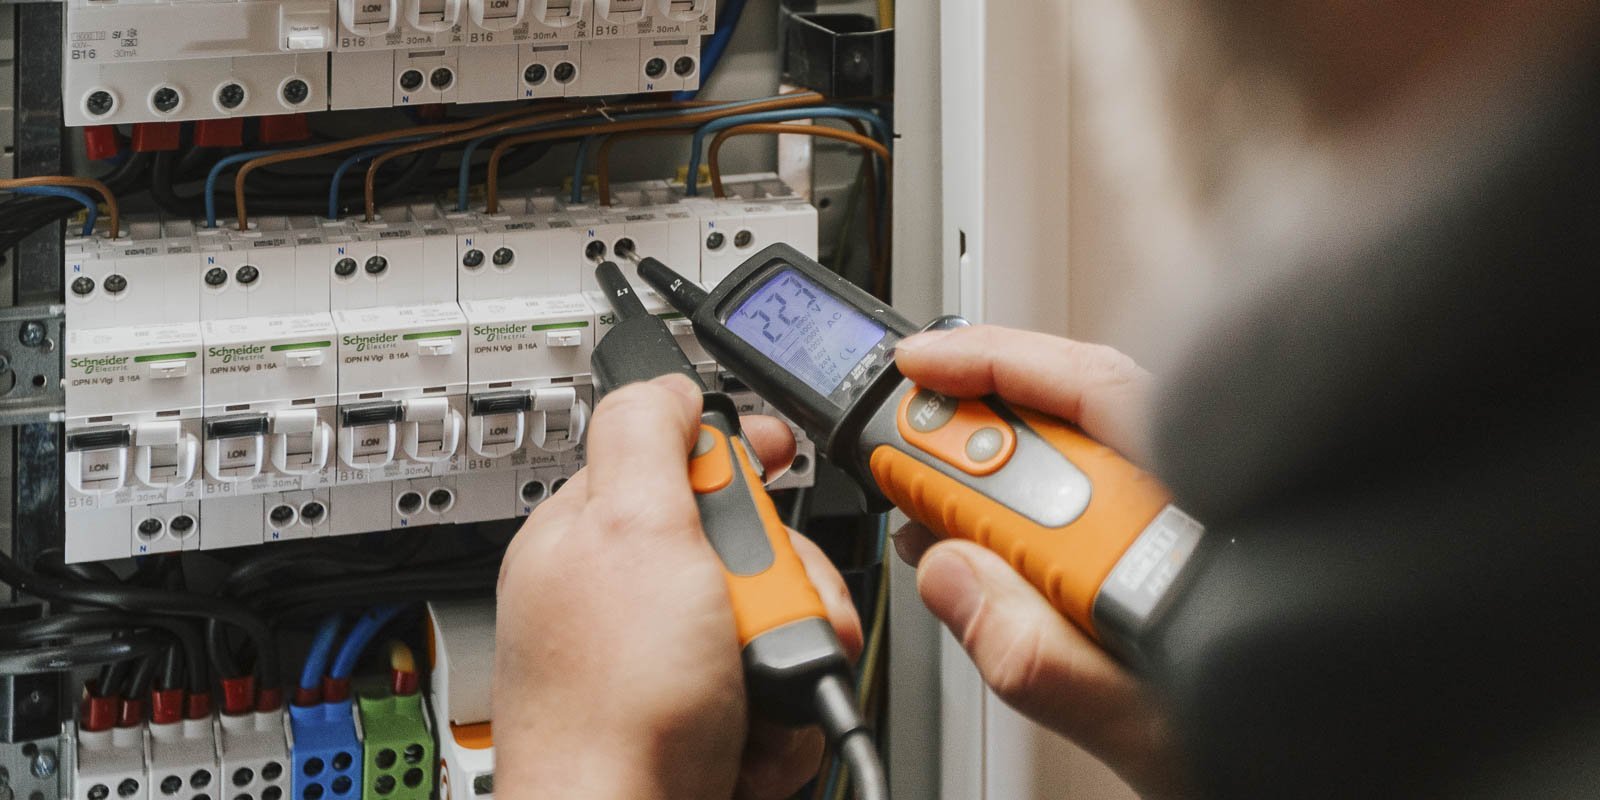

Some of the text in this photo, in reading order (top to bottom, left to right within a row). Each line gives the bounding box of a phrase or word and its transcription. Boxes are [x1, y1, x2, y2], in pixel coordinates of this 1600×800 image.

[596, 26, 619, 36] B16
[341, 37, 366, 48] B16
[470, 33, 494, 43] B16
[71, 49, 97, 60] B16
[646, 83, 653, 91] N
[709, 221, 715, 229] N
[588, 229, 595, 237] N
[337, 247, 345, 255] N
[207, 256, 215, 265] N
[73, 264, 81, 272] N
[669, 278, 683, 292] L2
[616, 287, 629, 297] L1
[827, 311, 842, 328] AC
[473, 323, 527, 336] Schneider
[343, 333, 398, 345] Schneider
[208, 344, 266, 357] Schneider
[525, 342, 538, 350] 16A
[70, 355, 129, 368] Schneider
[264, 362, 277, 370] 16A
[468, 460, 492, 470] B16
[340, 470, 364, 481] B16
[206, 482, 231, 494] B16
[68, 496, 93, 508] B16
